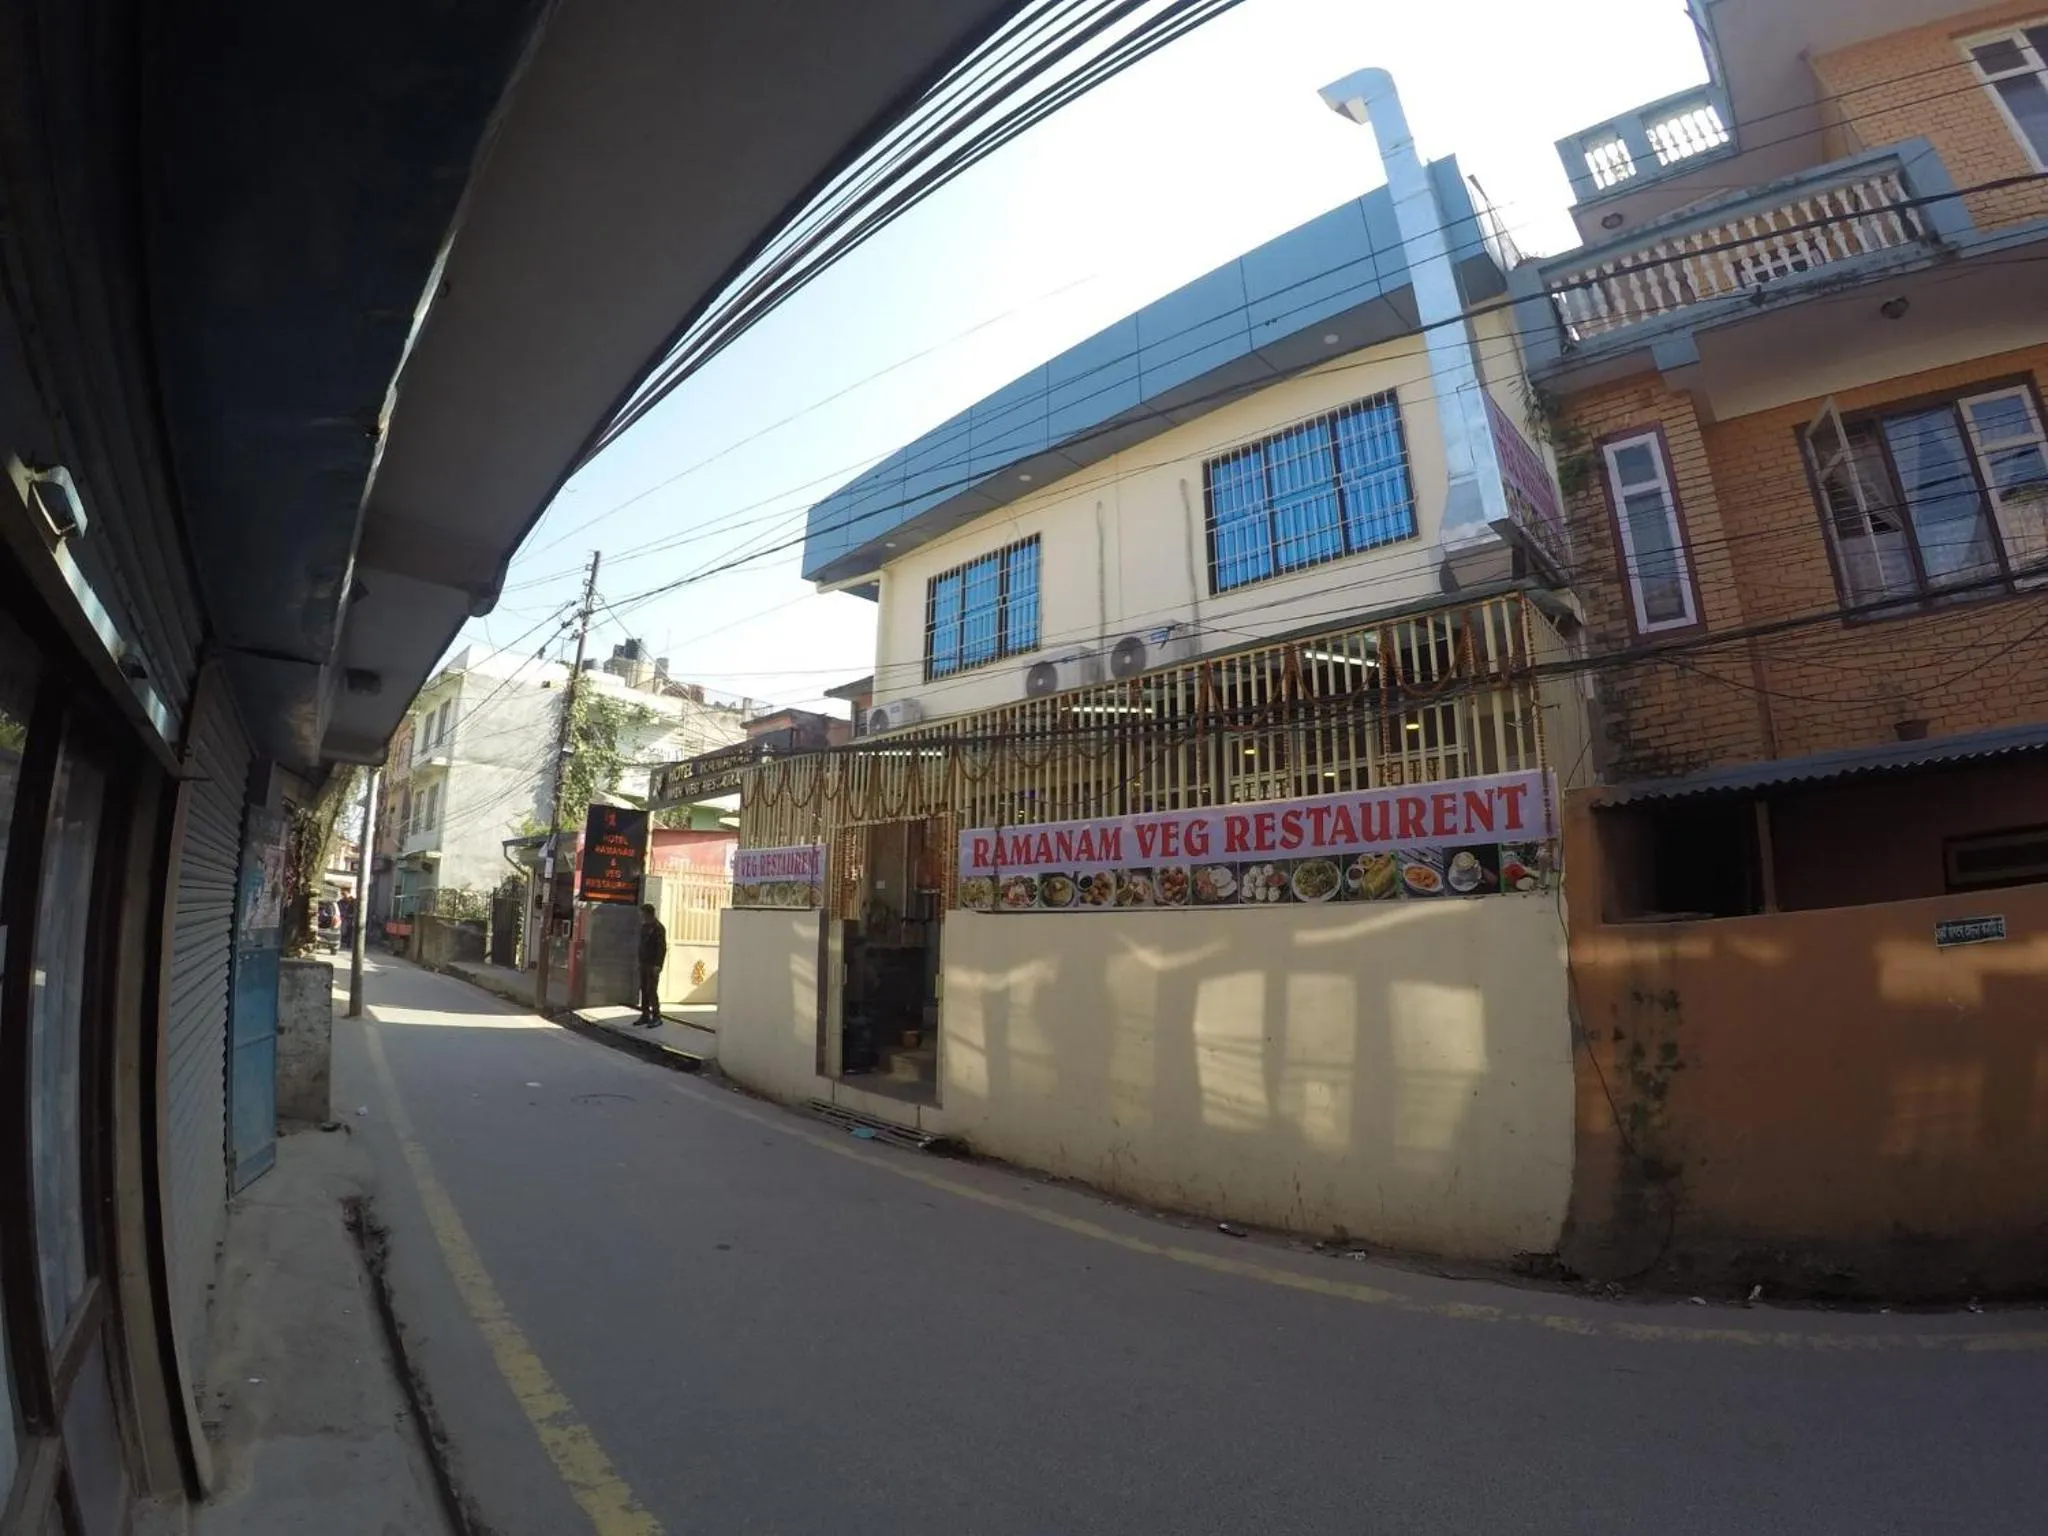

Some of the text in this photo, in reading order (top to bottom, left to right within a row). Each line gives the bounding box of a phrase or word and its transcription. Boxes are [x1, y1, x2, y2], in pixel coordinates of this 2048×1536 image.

[669, 762, 693, 782] HOTEL
[972, 783, 1527, 868] RAMANAM VEG RESTAURENT
[741, 849, 820, 877] VEG RESTAURENT
